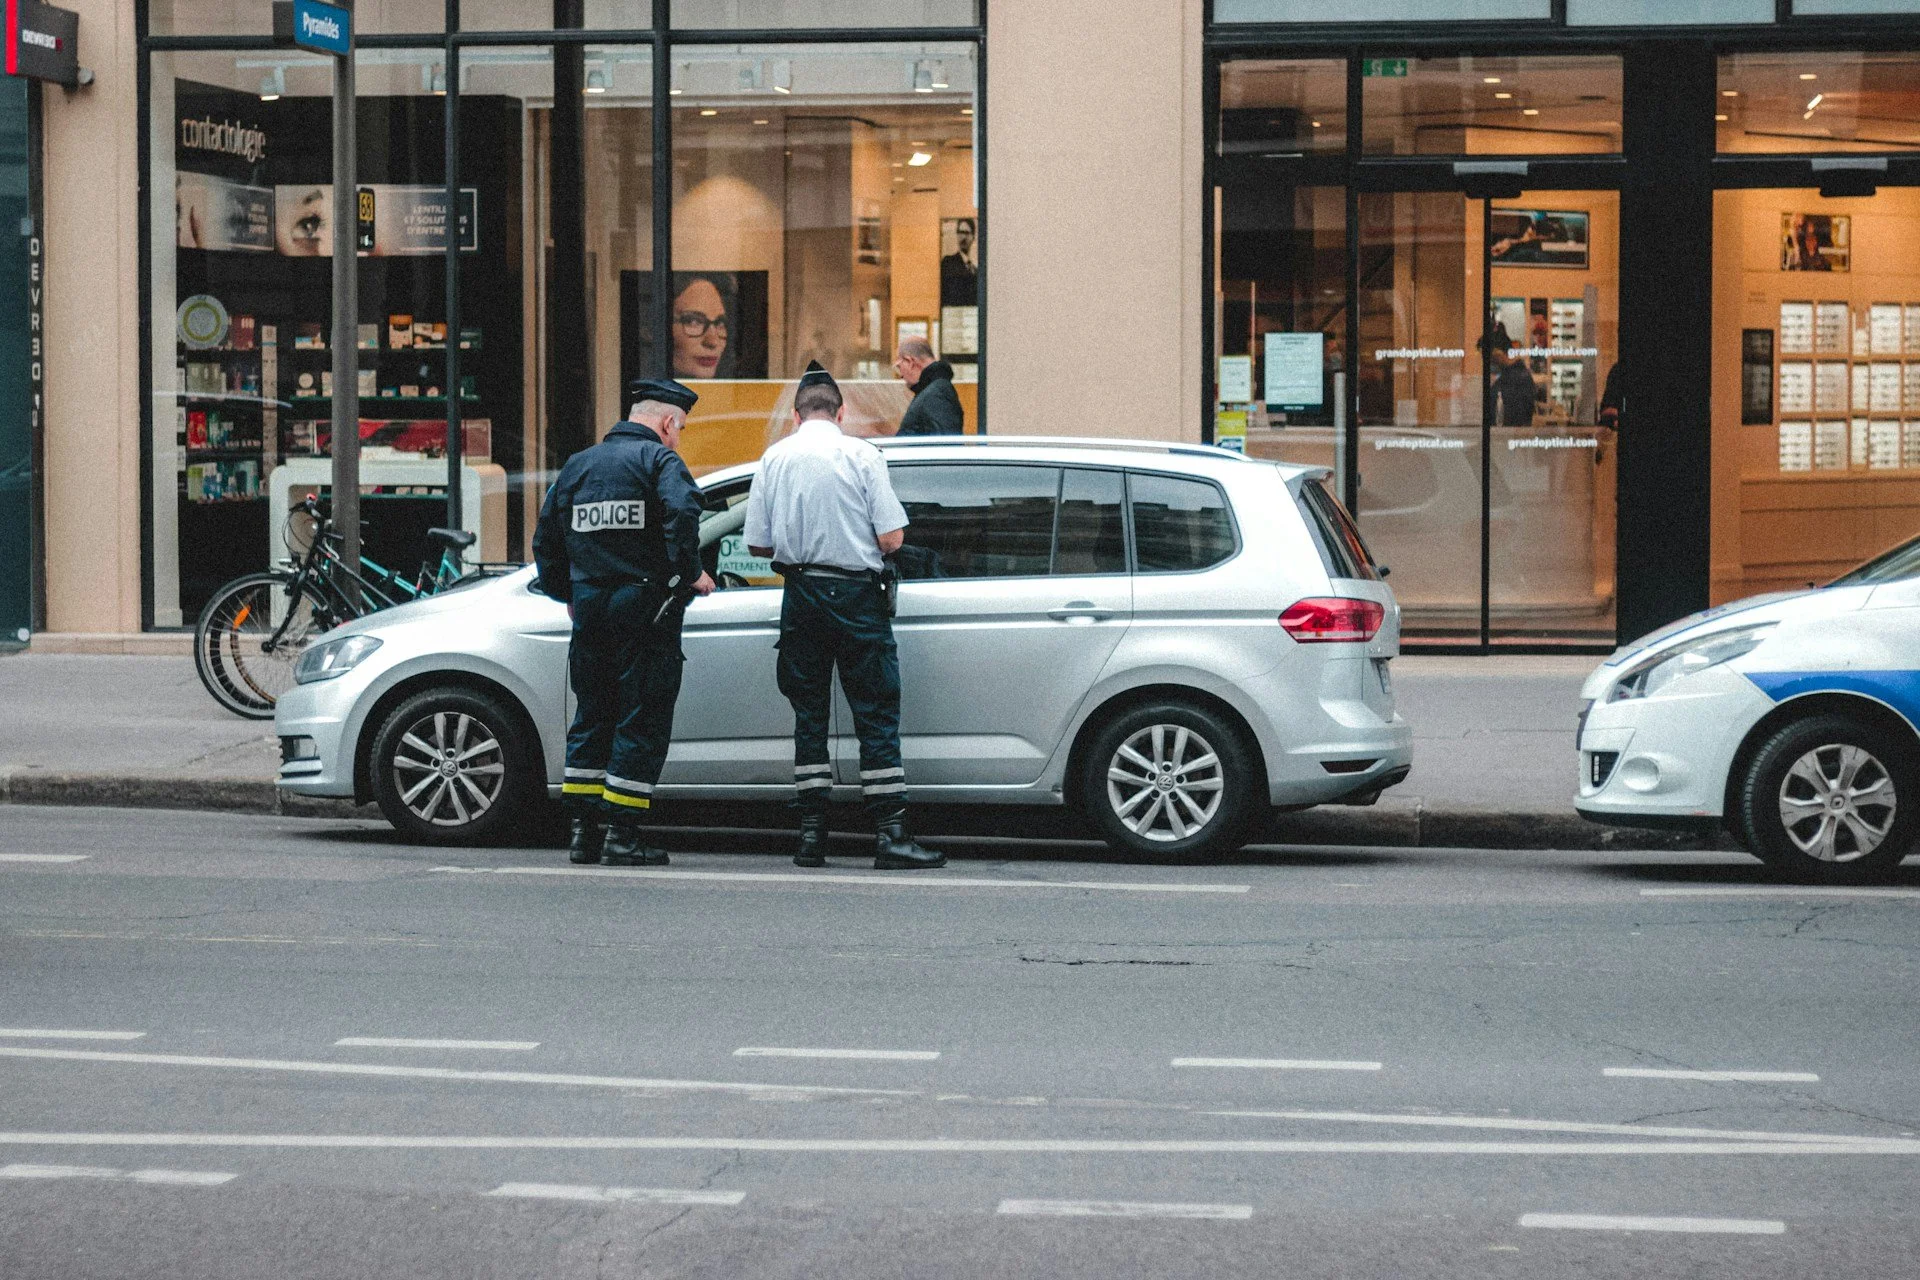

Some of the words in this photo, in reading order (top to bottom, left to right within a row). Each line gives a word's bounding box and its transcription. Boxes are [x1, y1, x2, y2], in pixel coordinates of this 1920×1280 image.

[302, 11, 340, 40] Pyramides
[181, 115, 266, 163] contactologie
[1375, 346, 1465, 361] grandoptical.com
[1507, 345, 1597, 359] grandoptical.com
[1374, 437, 1464, 450] grandoptical.com
[1507, 436, 1597, 450] grandoptical.com
[577, 504, 640, 528] POLICE
